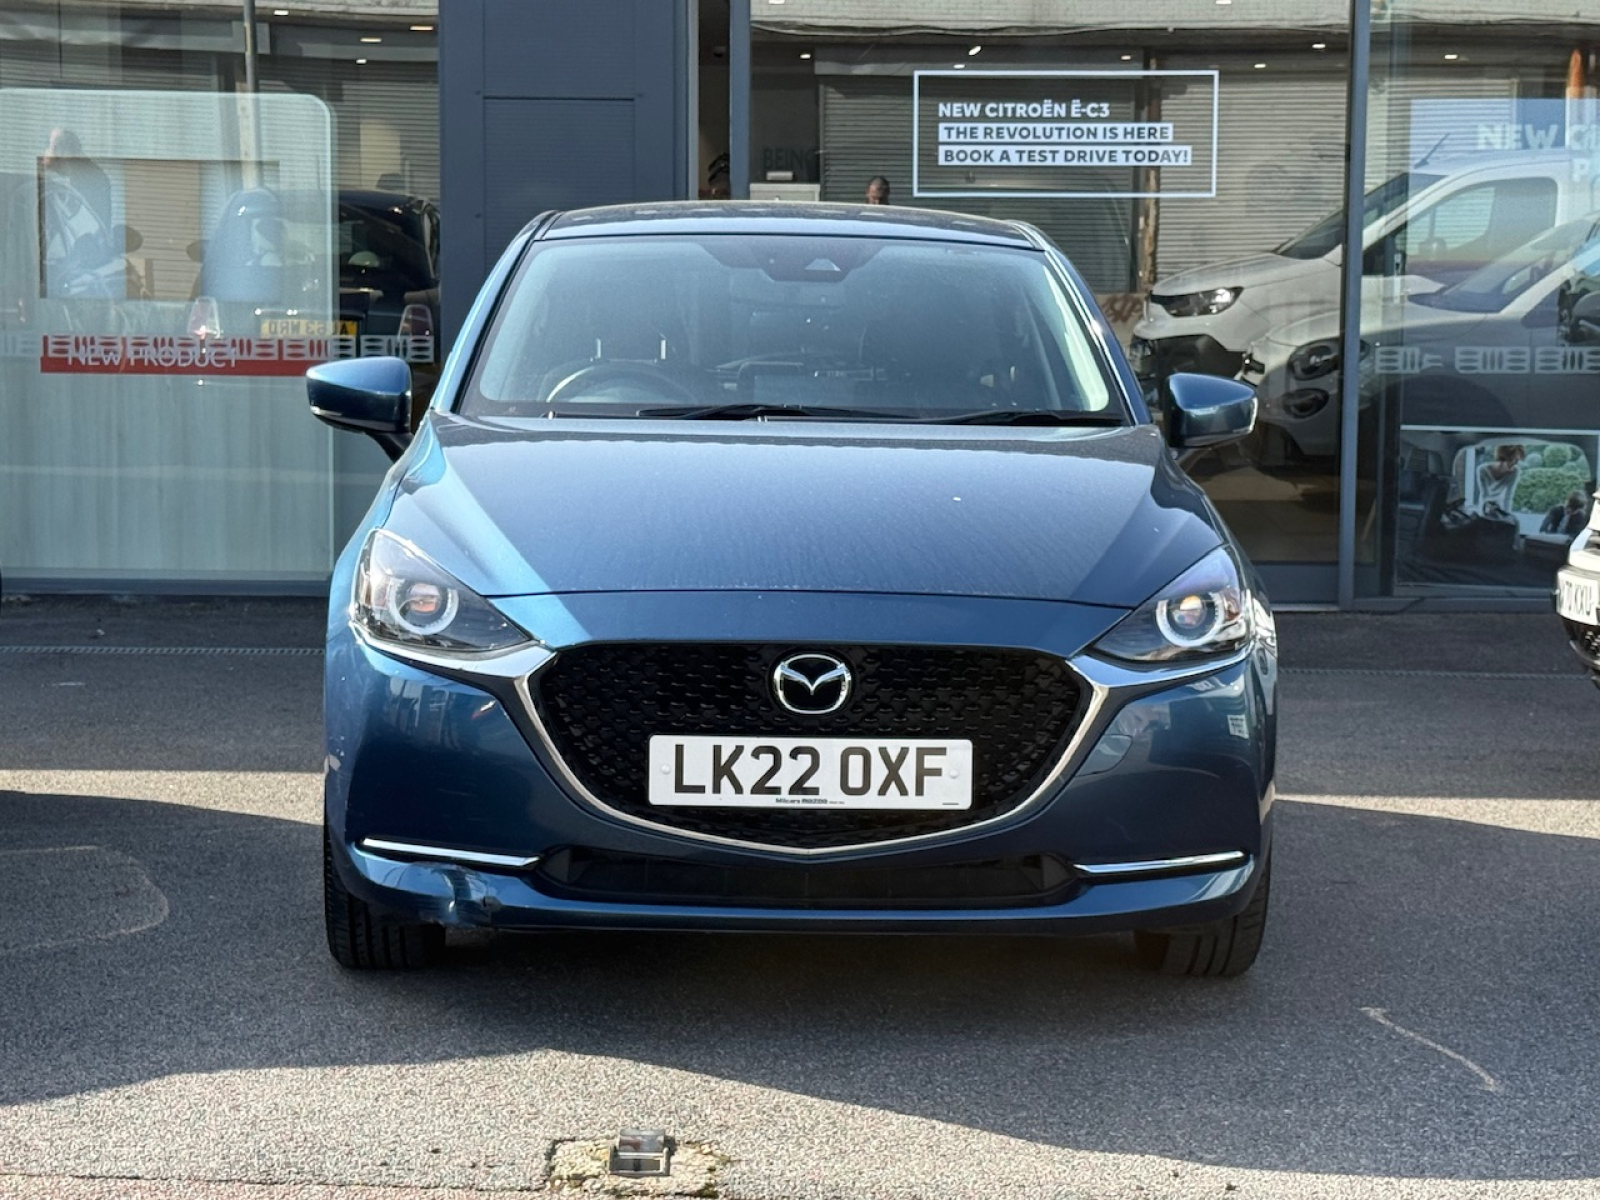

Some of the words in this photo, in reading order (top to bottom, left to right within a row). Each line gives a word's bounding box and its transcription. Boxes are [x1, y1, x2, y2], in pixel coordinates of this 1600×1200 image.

[938, 102, 982, 118] NEW
[984, 99, 1066, 118] CITROËN
[1070, 99, 1111, 118] Ë-C3
[944, 126, 979, 140] THE
[983, 126, 1098, 140] REVOLUTION
[1102, 126, 1119, 140] IS
[1123, 126, 1170, 140] HERE
[1477, 124, 1559, 150] NEW
[943, 149, 995, 163] BOOK
[998, 149, 1012, 163] A
[1015, 149, 1060, 163] TEST
[1063, 149, 1118, 163] DRIVE
[1121, 149, 1189, 163] TODAY!
[67, 346, 121, 367] NEW
[129, 347, 238, 368] PRODUCT
[674, 743, 820, 796] LK22
[839, 746, 948, 797] OXF
